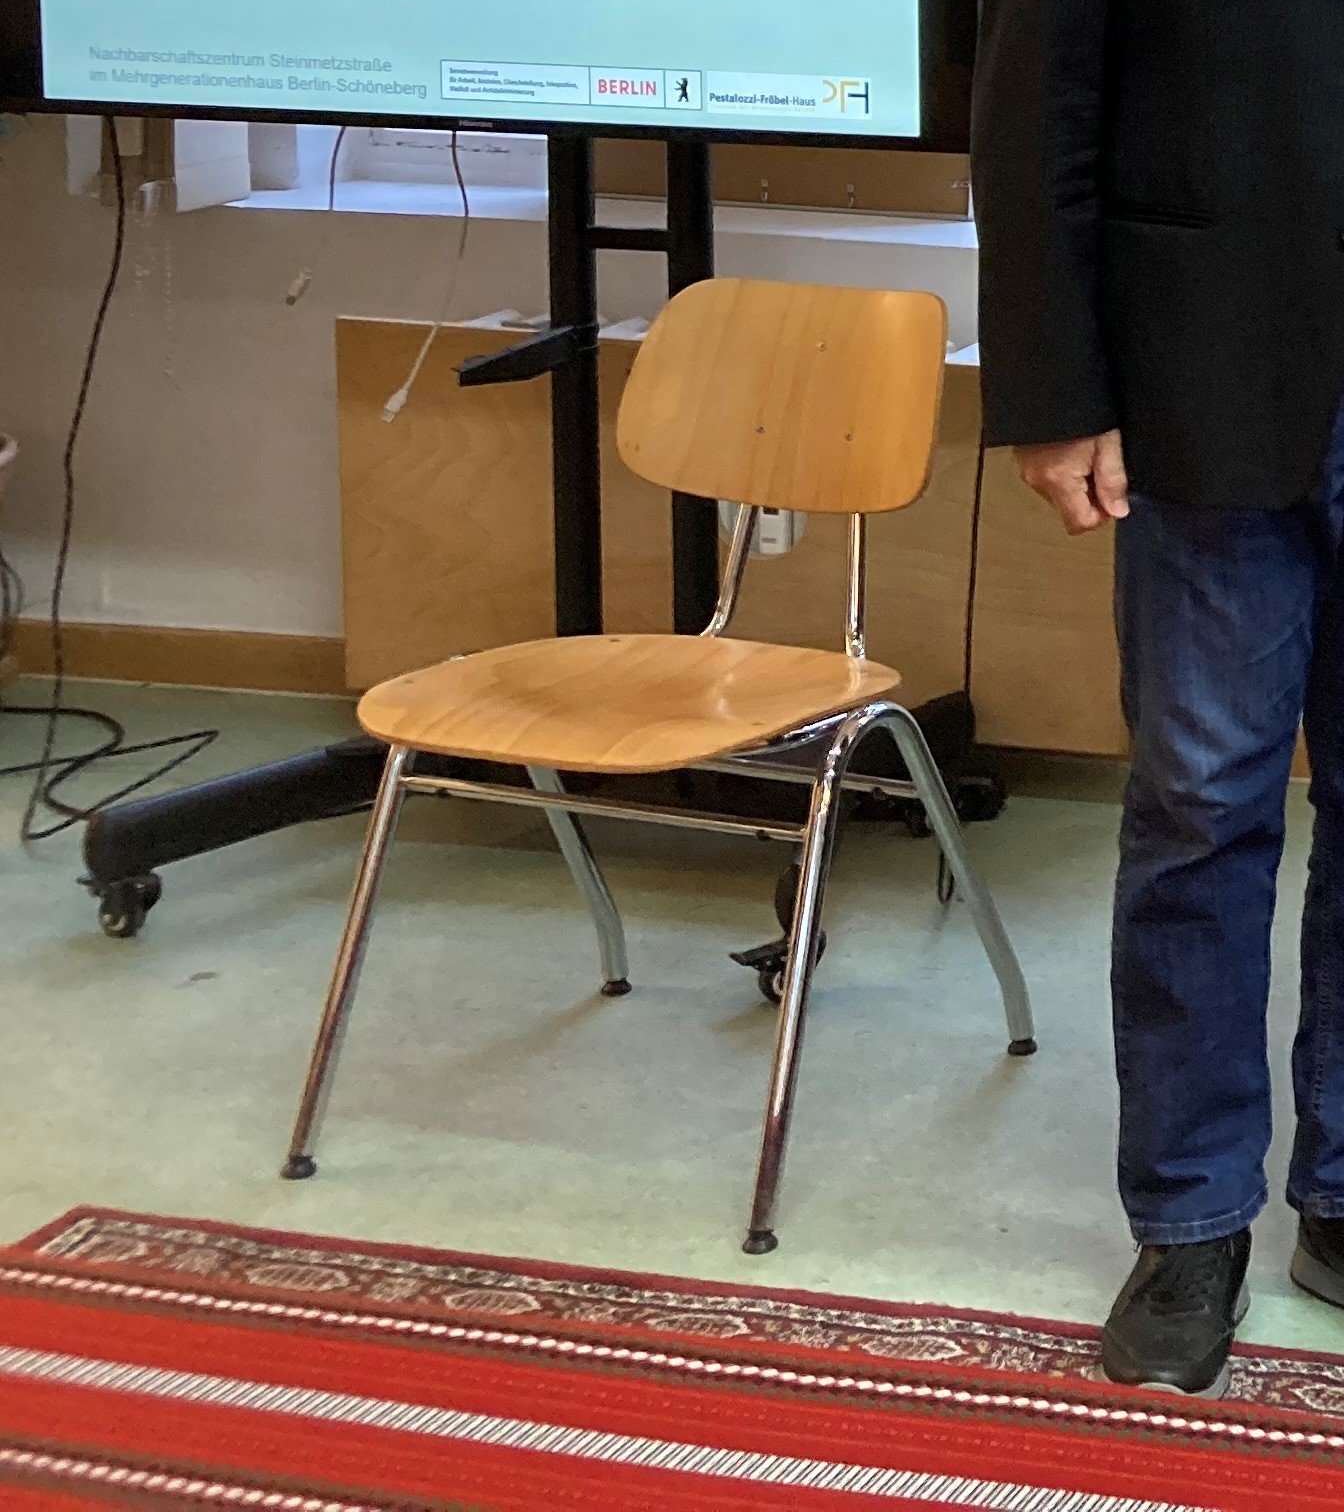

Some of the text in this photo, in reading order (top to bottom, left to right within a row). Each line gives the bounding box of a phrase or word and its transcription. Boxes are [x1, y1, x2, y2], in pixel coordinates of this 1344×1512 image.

[88, 45, 392, 74] Nachbarschaftszentrum Steinmetzstraße
[89, 68, 428, 100] im Mehrgenerationenhaus Berlin-Schöneberg
[598, 79, 657, 96] BERLIN
[709, 92, 817, 107] Pestalozzi-Fröbel-Haus
